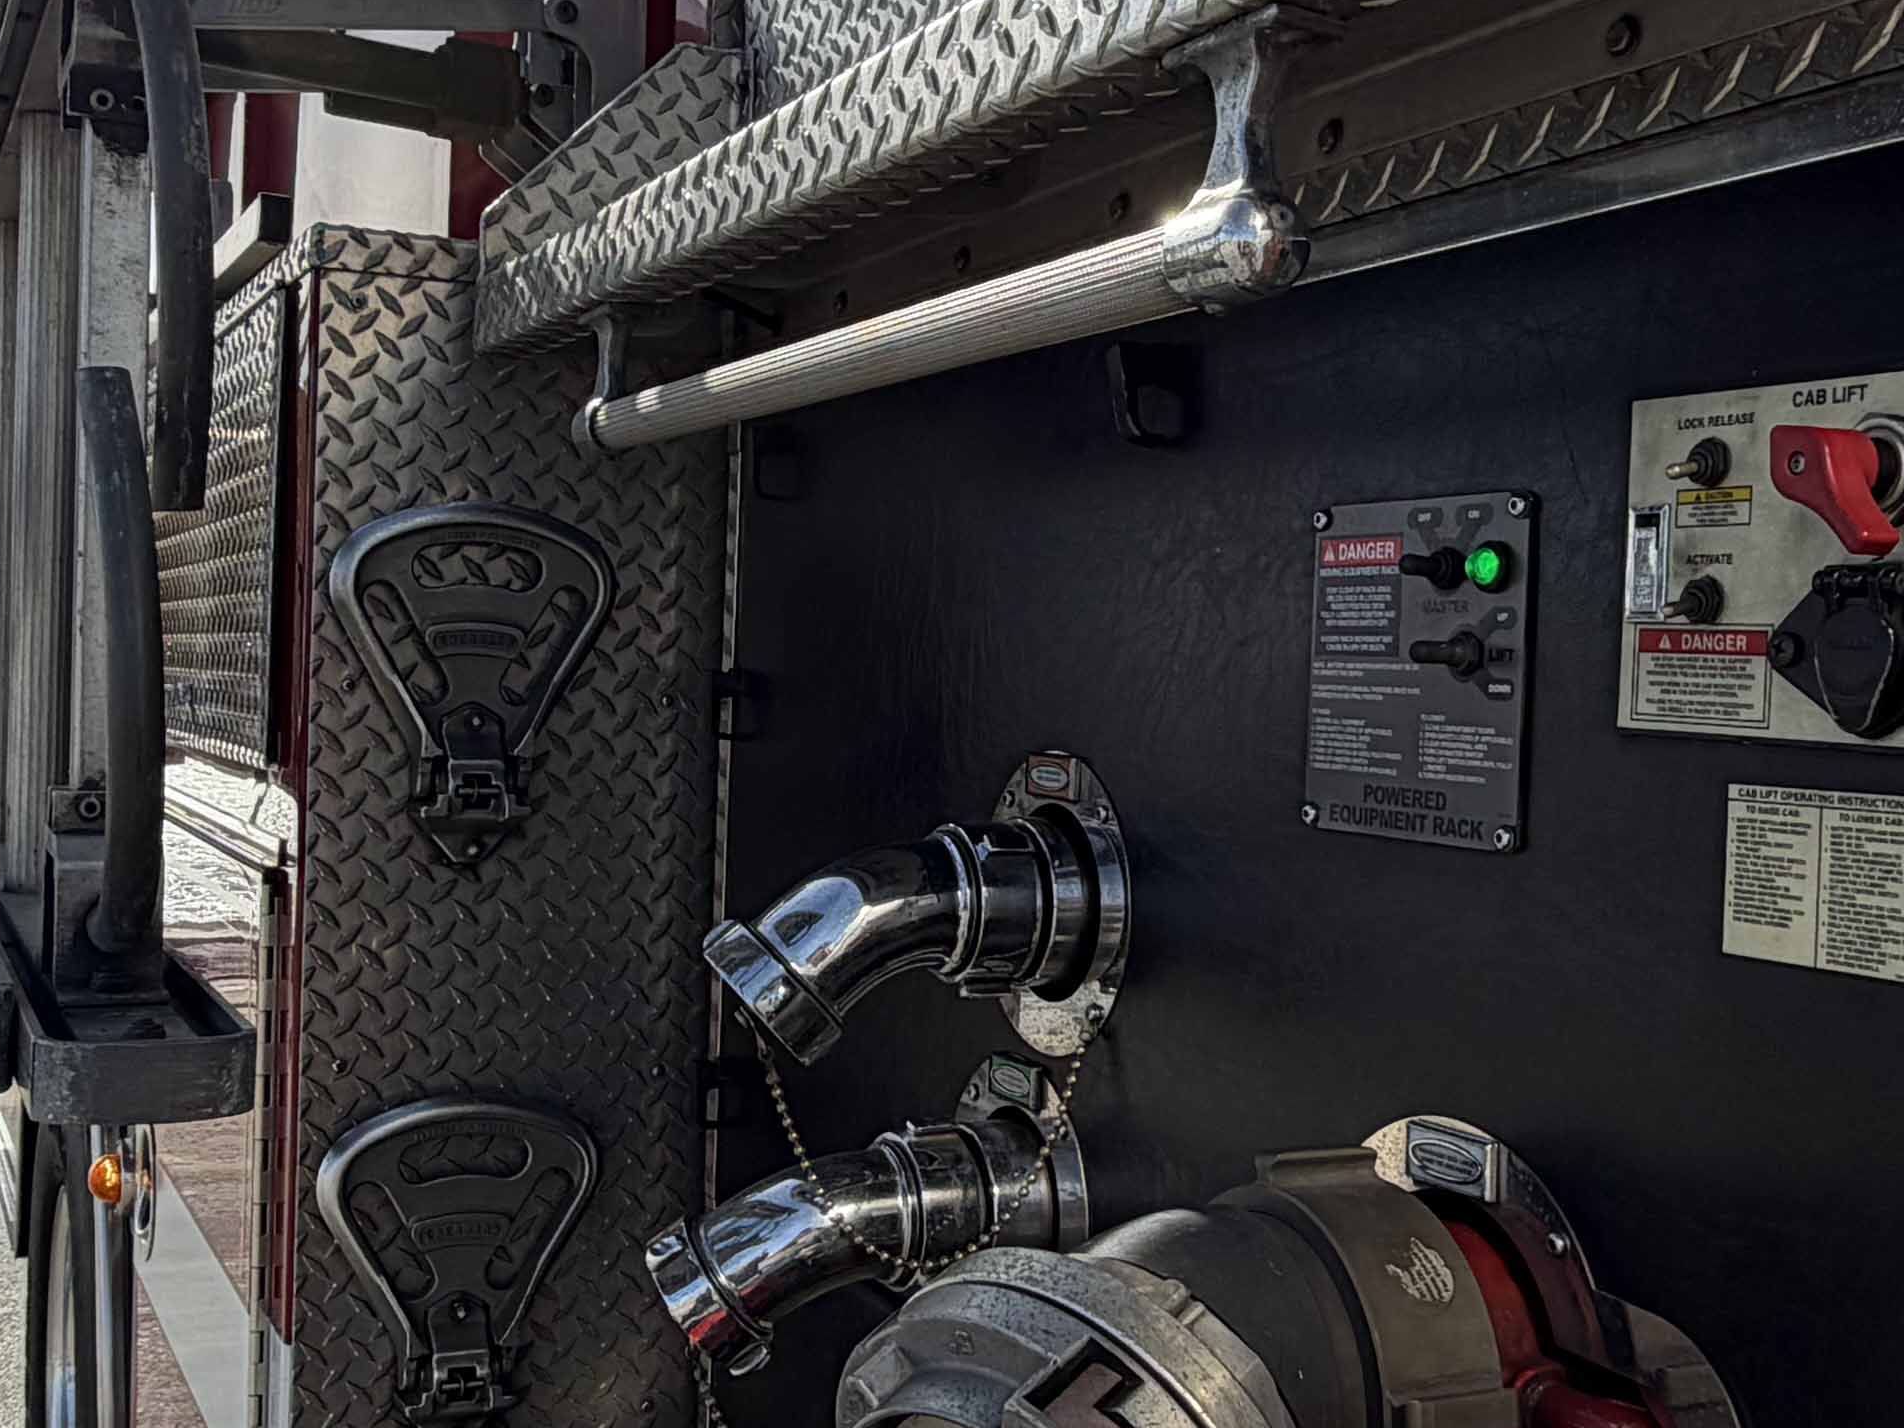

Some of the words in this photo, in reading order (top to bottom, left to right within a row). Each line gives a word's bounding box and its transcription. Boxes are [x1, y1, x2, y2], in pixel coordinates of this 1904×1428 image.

[1792, 388, 1827, 408] CAB
[1831, 384, 1869, 404] LIFT
[1677, 416, 1706, 430] LOCK
[1708, 412, 1755, 427] RELEASE
[1338, 541, 1395, 561] DANGER
[1686, 553, 1733, 565] ACTIVATE
[1422, 600, 1469, 613] MASTER
[1681, 634, 1747, 652] DANGER
[1488, 648, 1514, 661] LIFT
[1488, 684, 1512, 693] DOWN
[1363, 783, 1447, 811] POWERED
[1738, 788, 1758, 798] CAB
[1759, 789, 1779, 800] LIFT
[1781, 790, 1835, 805] OPERATING
[1329, 803, 1426, 836] EQUIPMENT
[1432, 815, 1484, 841] RACK
[1839, 813, 1850, 822] TO
[1852, 814, 1883, 825] LOWER
